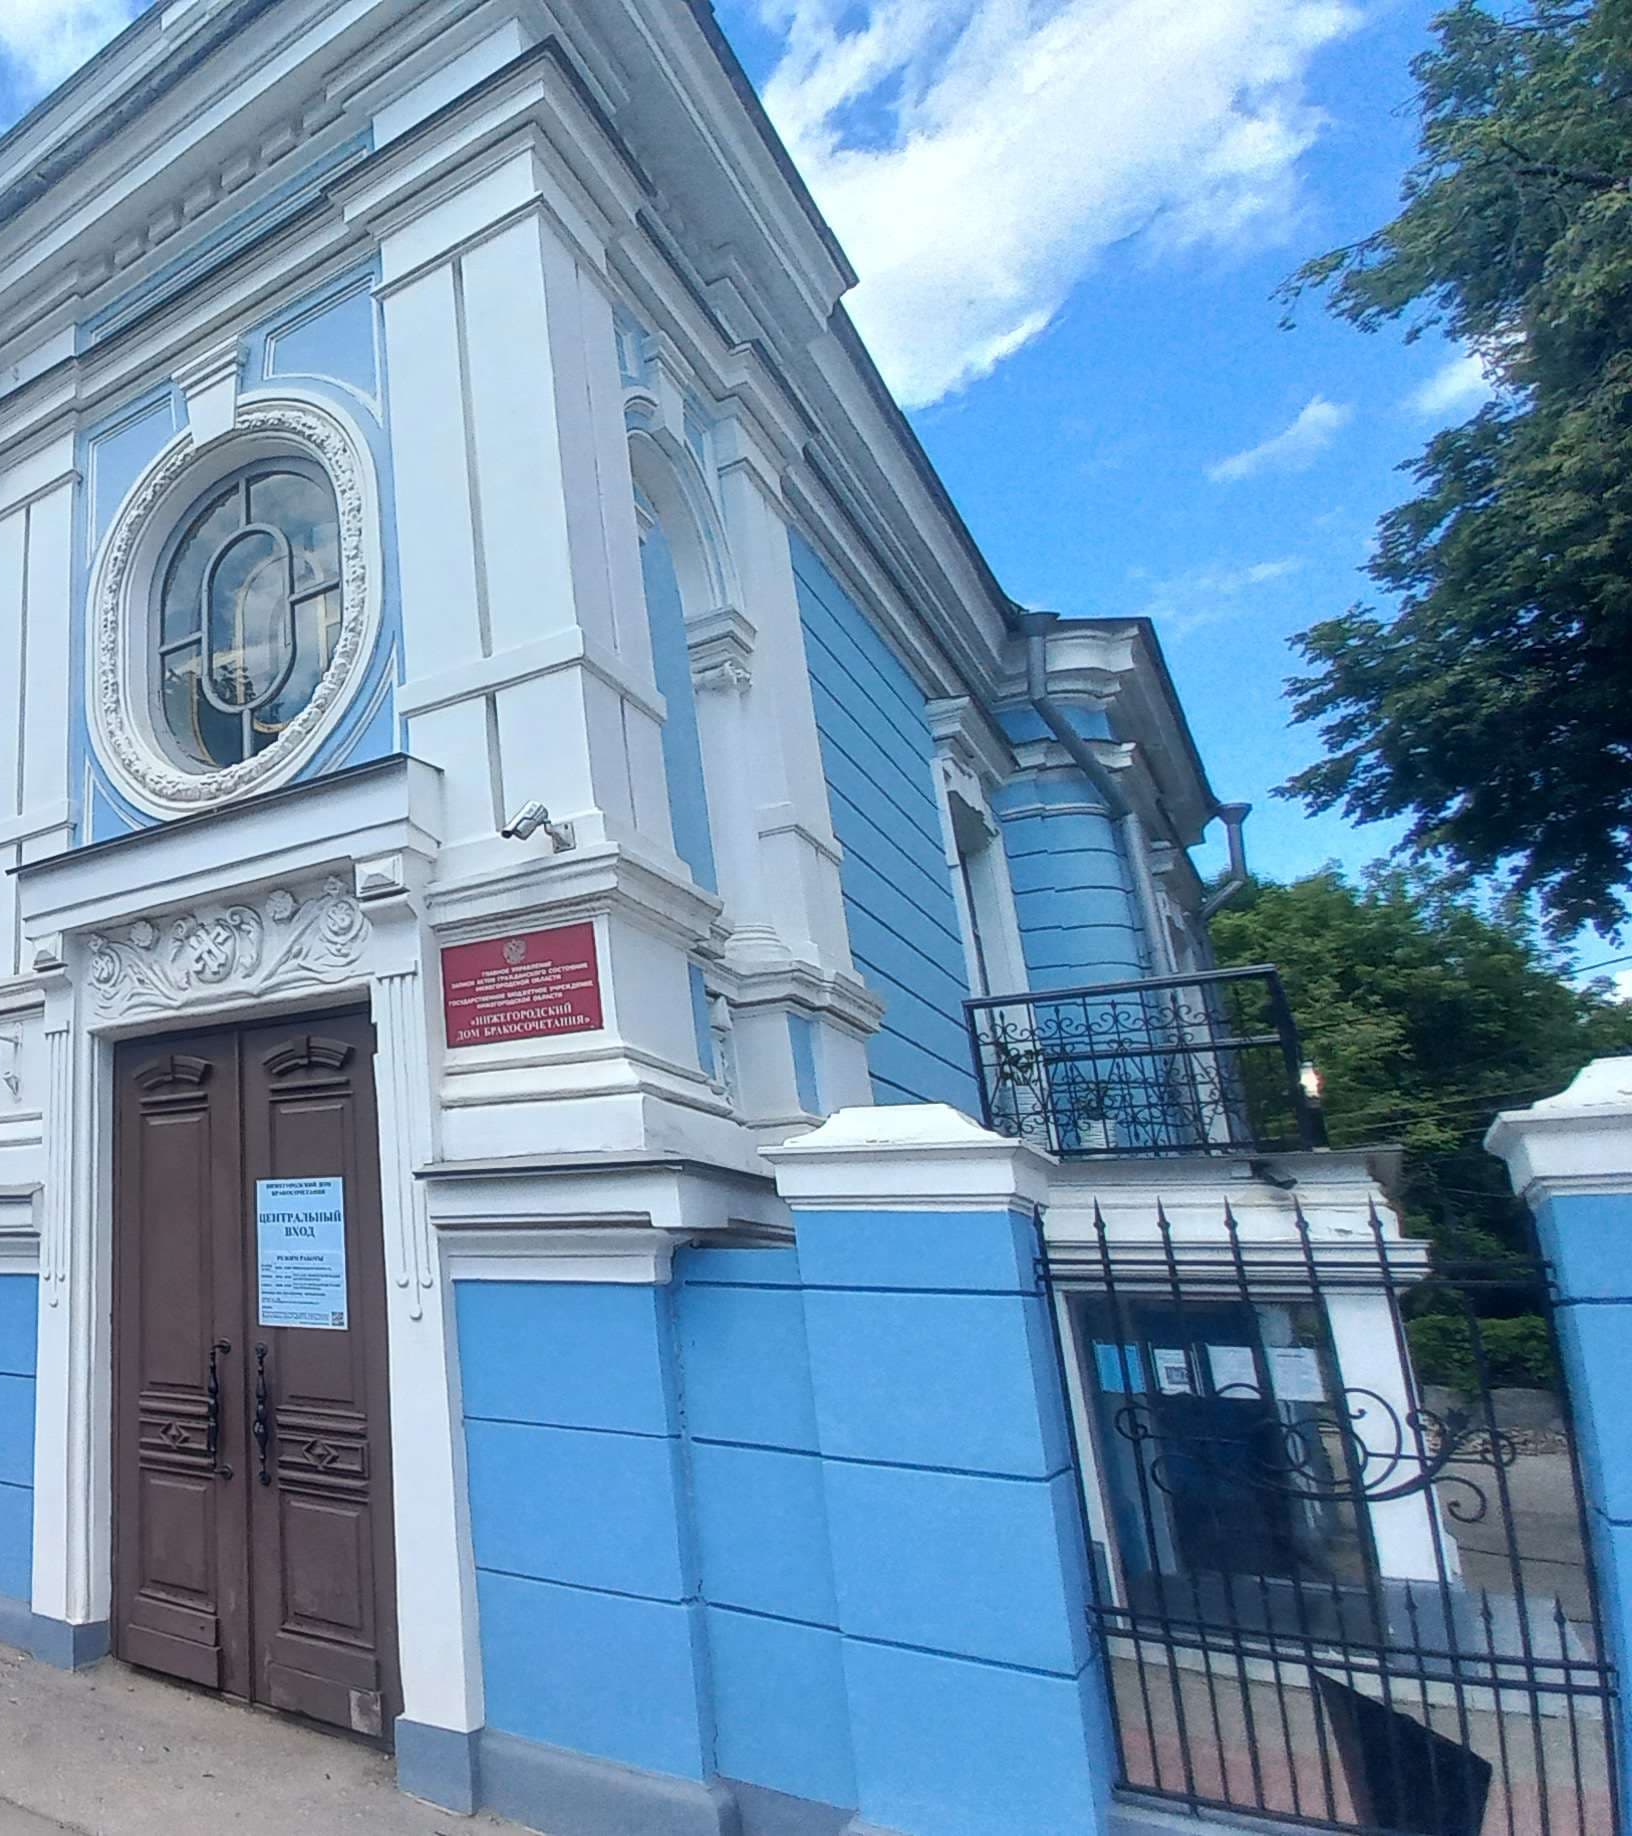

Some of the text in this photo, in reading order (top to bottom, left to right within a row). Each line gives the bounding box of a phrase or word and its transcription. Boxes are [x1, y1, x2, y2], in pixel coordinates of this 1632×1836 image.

[457, 1029, 480, 1041] ДОМ
[259, 1210, 342, 1224] ЦЕНТРАЛЬНЫЙ
[285, 1226, 316, 1238] ВХОД
